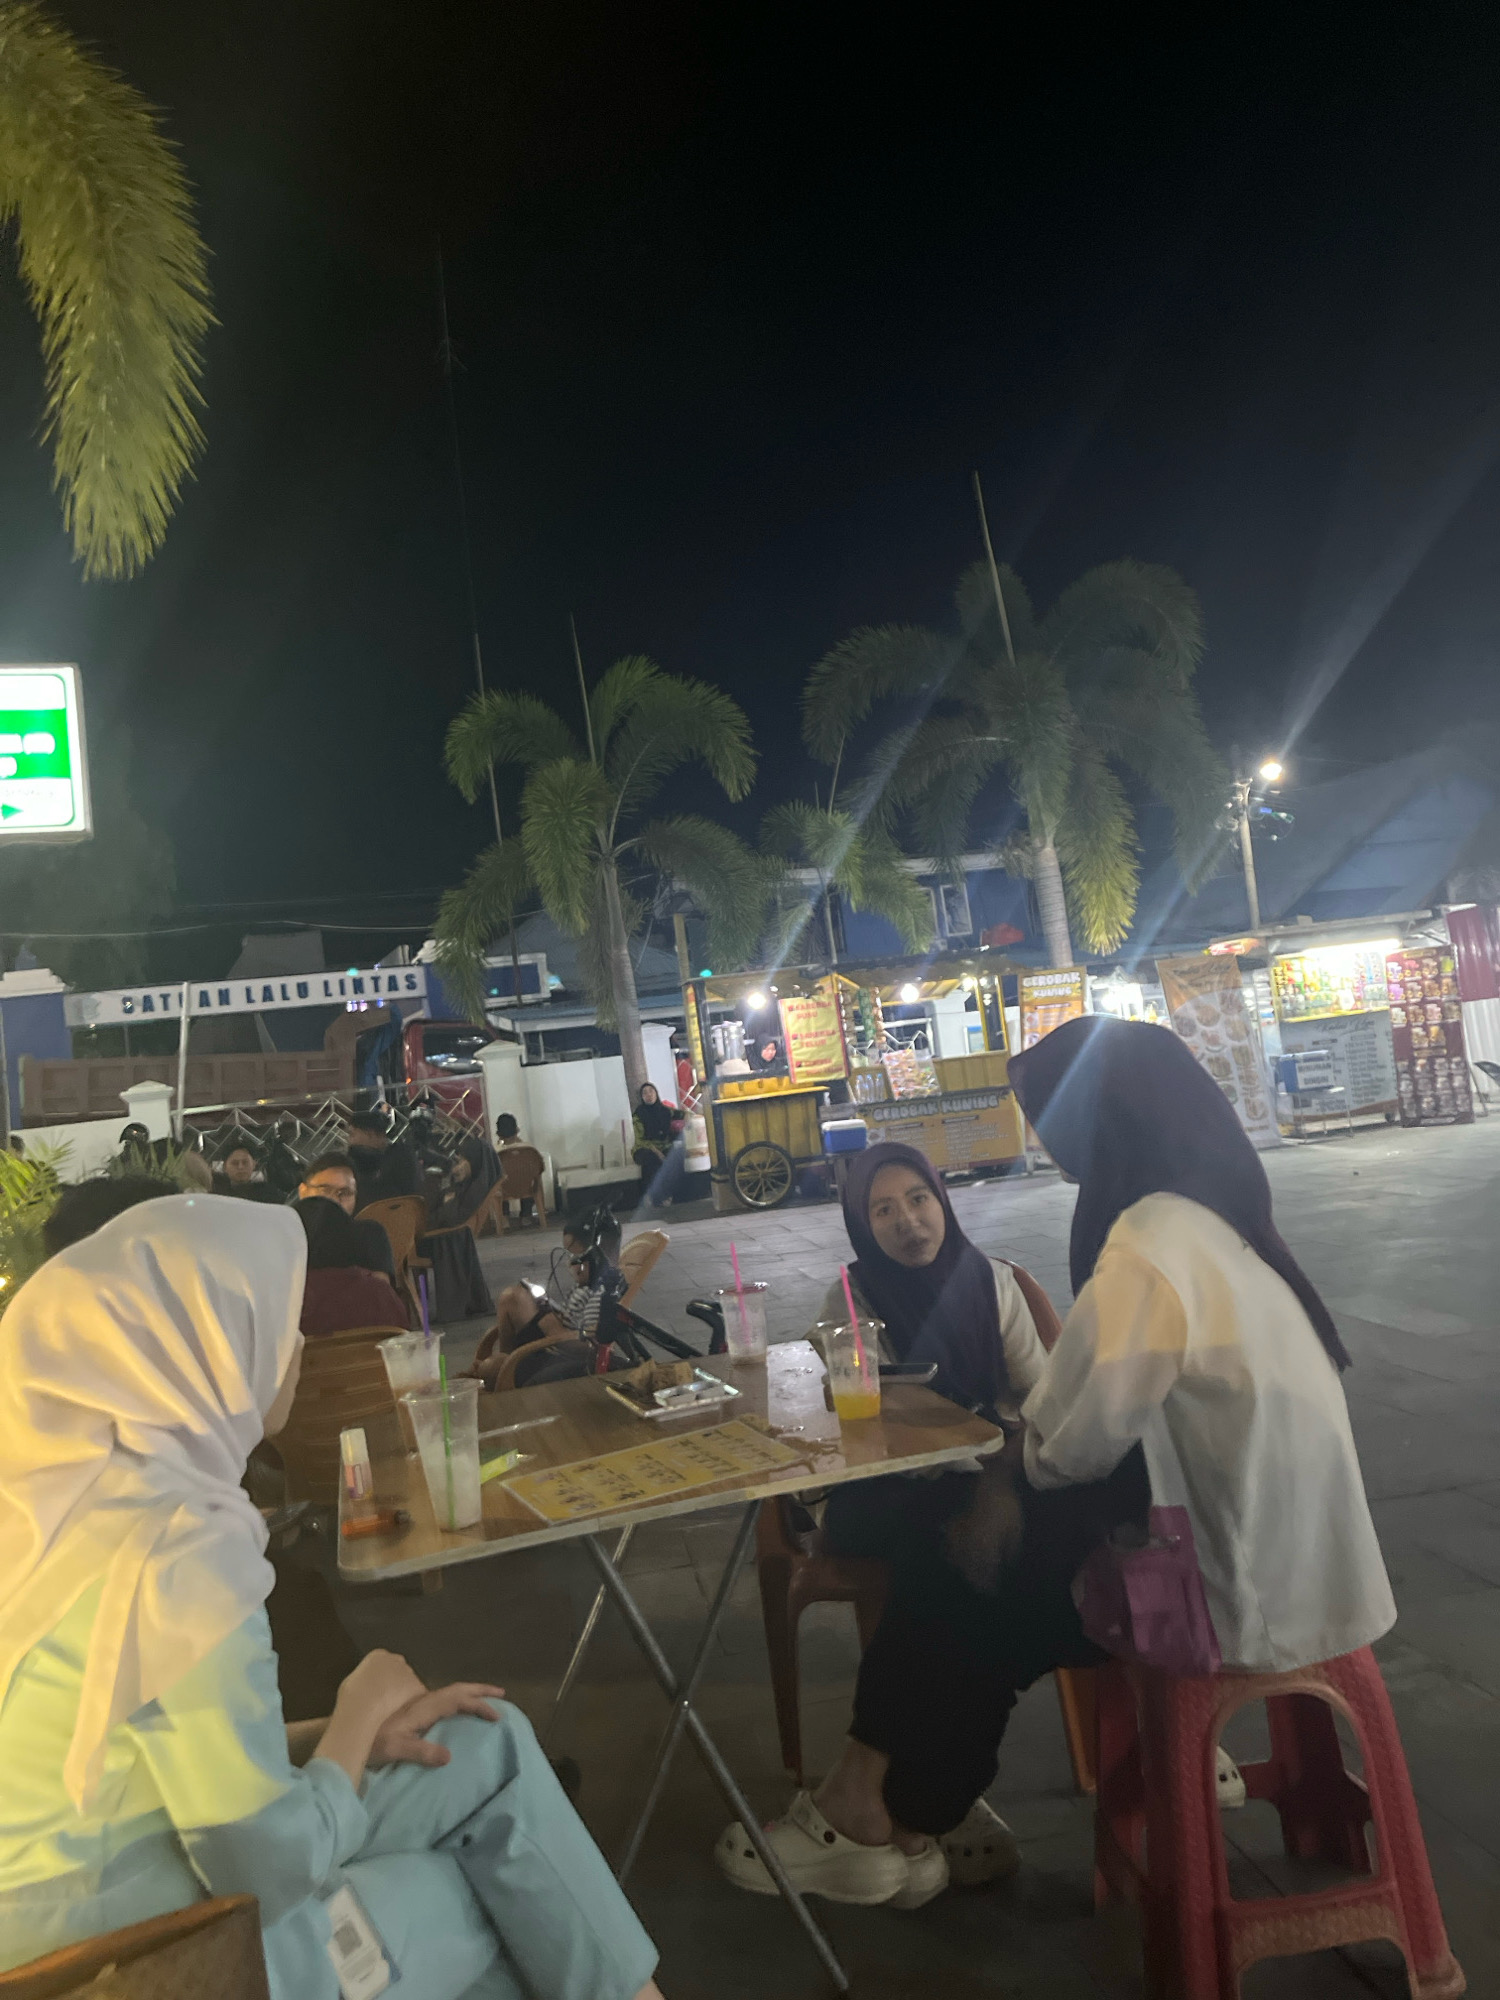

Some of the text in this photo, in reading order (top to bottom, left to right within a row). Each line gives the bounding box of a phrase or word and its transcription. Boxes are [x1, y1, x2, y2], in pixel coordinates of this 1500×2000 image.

[246, 982, 309, 1003] LALU
[323, 973, 417, 997] LINTAS
[1023, 971, 1081, 987] GEROBAK
[873, 1102, 939, 1121] GEROBAK
[941, 1095, 999, 1113] KUNING
